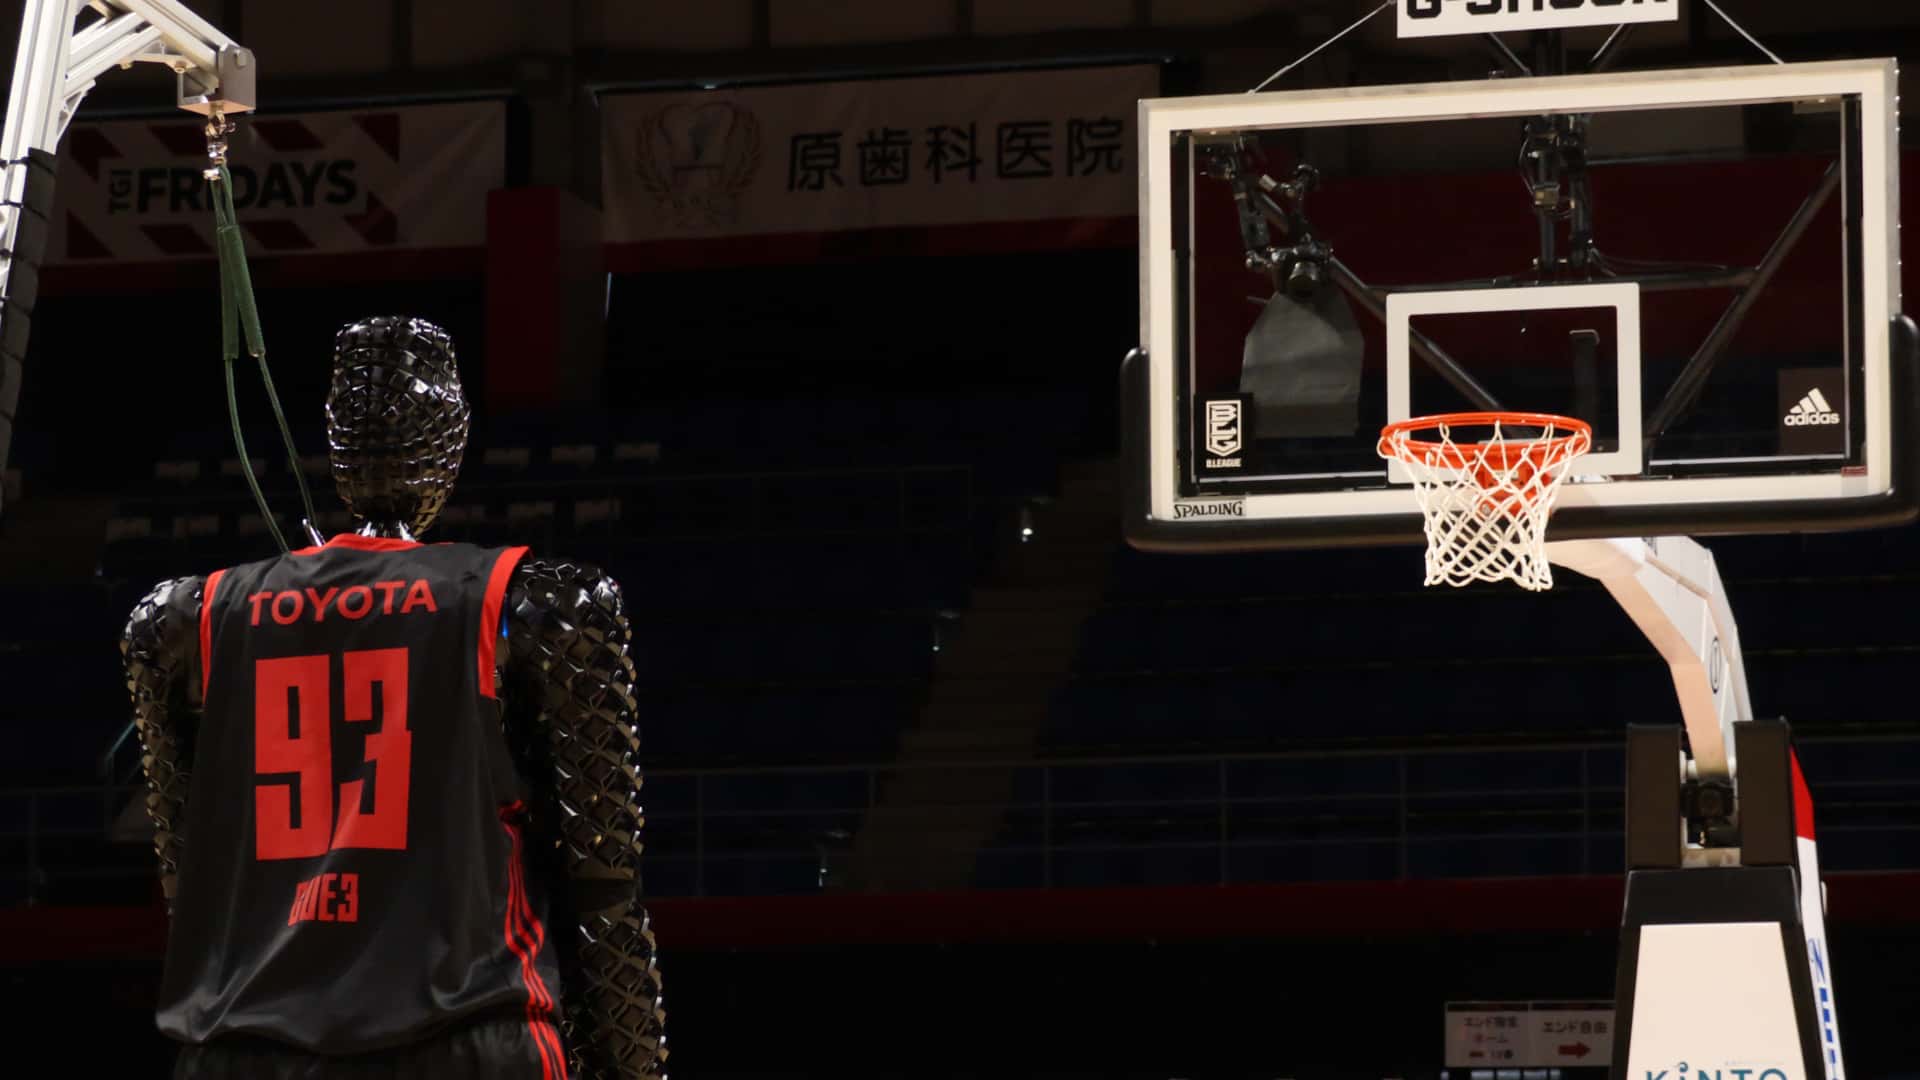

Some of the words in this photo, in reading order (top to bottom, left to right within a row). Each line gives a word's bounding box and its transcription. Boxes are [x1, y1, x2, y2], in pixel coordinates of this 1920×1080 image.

[787, 116, 1125, 192] 原歯科医院
[109, 168, 132, 214] TGI
[1784, 412, 1840, 426] adidas
[1173, 501, 1243, 519] SPALDING
[248, 579, 438, 626] TOYOTA
[255, 646, 412, 861] 93
